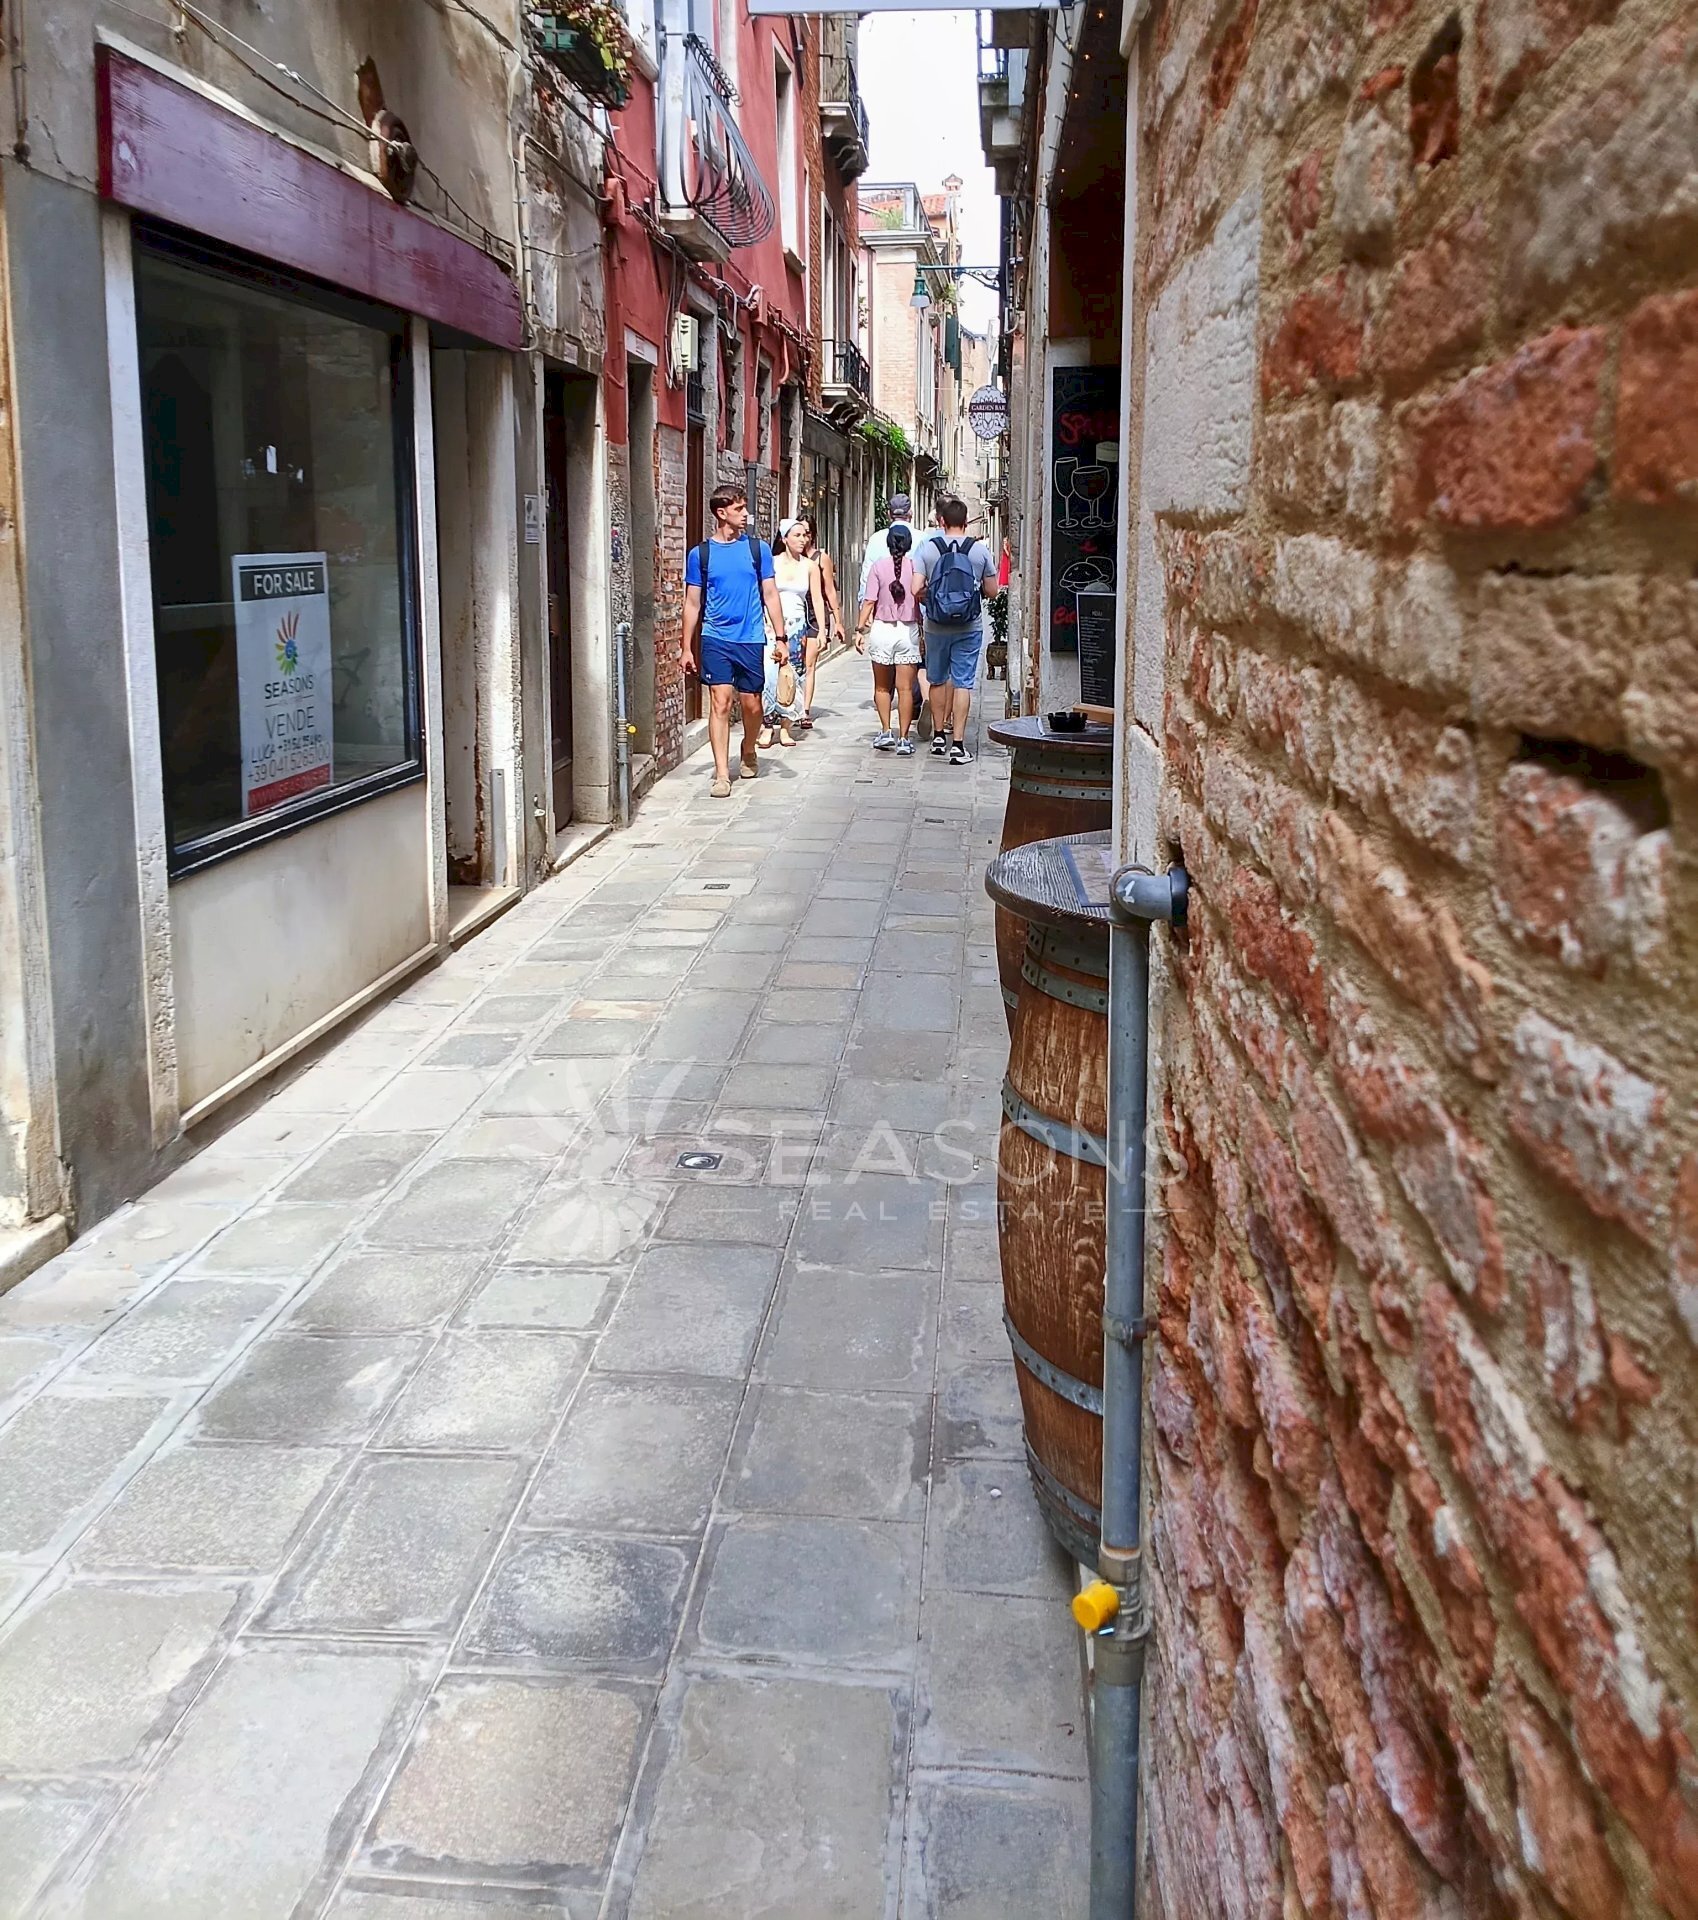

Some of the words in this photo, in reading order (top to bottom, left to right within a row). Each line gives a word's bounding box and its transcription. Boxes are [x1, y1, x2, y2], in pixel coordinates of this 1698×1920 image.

[253, 573, 283, 595] FOR
[285, 571, 316, 593] SALE
[264, 674, 315, 700] SEASONS
[264, 705, 316, 739] VENDE
